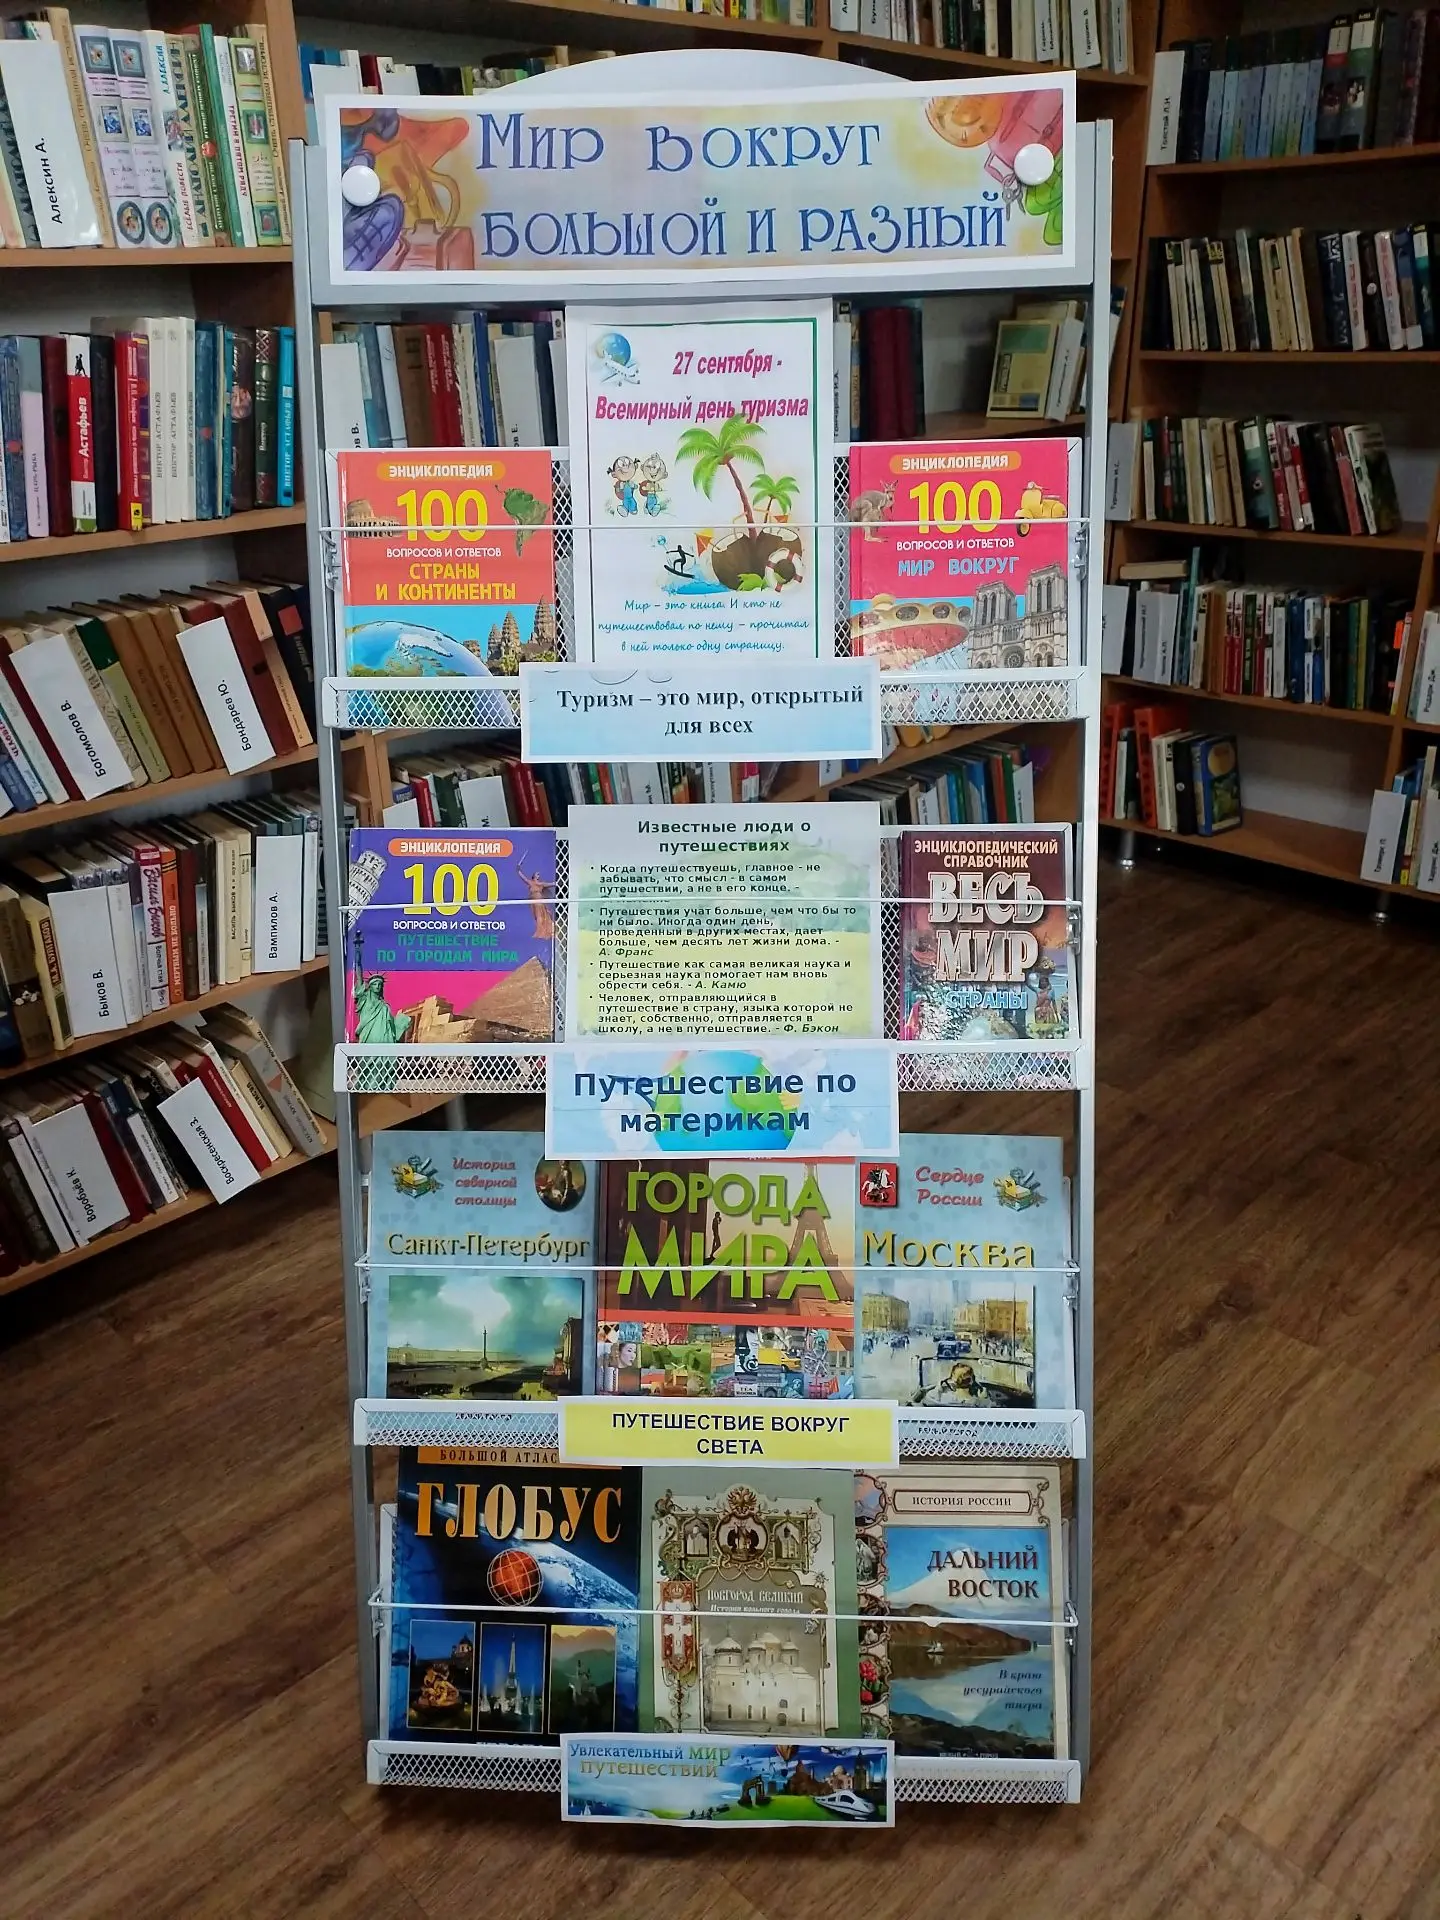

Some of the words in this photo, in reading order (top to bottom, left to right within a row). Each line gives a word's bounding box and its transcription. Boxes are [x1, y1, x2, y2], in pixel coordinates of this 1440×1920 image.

[35, 137, 46, 153] А.
[40, 155, 63, 224] Алексин
[673, 352, 693, 375] 27
[698, 349, 772, 378] сентября
[596, 395, 692, 425] Всемирный
[696, 400, 735, 422] день
[741, 397, 808, 423] туризма
[76, 397, 92, 457] Астафьев
[902, 454, 1009, 470] ЭНЦИКЛОПЕДИЯ
[389, 465, 493, 479] ЭНЦИКЛОПЕДИЯ
[397, 489, 488, 542] 100
[910, 480, 1002, 534] 100
[387, 548, 442, 558] ВОПРОСОВ
[444, 549, 452, 557] И
[455, 547, 501, 557] ОТВЕТОВ
[897, 540, 953, 551] ВОПРОСОВ
[956, 540, 964, 549] И
[967, 538, 1014, 549] ОТВЕТОВ
[409, 563, 480, 580] СТРАНЫ
[898, 560, 934, 576] МИР
[949, 557, 1019, 575] ВОКРУГ
[376, 584, 387, 601] И
[399, 583, 516, 600] КОНТИНЕНТЫ
[624, 599, 650, 611] Мир
[665, 601, 687, 609] это
[690, 600, 725, 609] книга.
[730, 599, 738, 608] И
[743, 600, 767, 609] кто
[769, 600, 782, 608] не
[598, 621, 685, 633] путешествовал
[705, 622, 733, 633] нему
[750, 621, 809, 631] прочитал
[622, 642, 626, 651] в
[630, 641, 648, 651] ней
[652, 642, 694, 651] только
[696, 641, 720, 653] одну
[725, 641, 784, 652] страницу.
[218, 679, 228, 694] Ю.
[61, 700, 72, 712] В.
[557, 689, 634, 713] Туризм
[657, 692, 690, 706] это
[697, 691, 745, 712] мир,
[751, 686, 863, 711] открытый
[224, 698, 251, 750] Бондарев
[665, 720, 701, 736] для
[709, 719, 753, 733] всех
[69, 712, 106, 777] Богомолов
[638, 821, 737, 834] Известные
[743, 821, 793, 833] люди
[801, 821, 811, 832] о
[401, 842, 500, 854] ЭНЦИКЛОПЕДИЯ
[660, 840, 789, 853] путешествиях
[914, 839, 1057, 854] ЭНЦИКЛОПЕДИЧЕСКИЙ
[600, 864, 636, 874] Когда
[640, 864, 741, 875] путешествуешь,
[746, 863, 793, 872] главное
[807, 863, 820, 871] не
[944, 855, 1028, 868] СПРАВОЧНИК
[268, 891, 279, 904] А.
[404, 863, 499, 916] 100
[928, 871, 1043, 925] ВЕСЬ
[268, 905, 279, 960] Вампилов
[393, 920, 447, 930] ВОПРОСОВ
[450, 921, 458, 930] И
[460, 920, 505, 930] ОТВЕТОВ
[398, 934, 497, 947] ПУТЕШЕСТВИЕ
[377, 950, 396, 962] ПО
[407, 950, 471, 964] ГОРОДАМ
[482, 950, 518, 962] МИРА
[599, 960, 680, 970] Путешествие
[749, 960, 800, 968] великая
[804, 960, 840, 969] наука
[935, 930, 1038, 983] МИР
[92, 969, 103, 979] В.
[96, 982, 110, 1017] Быков
[947, 990, 1027, 1010] СТРАНЫ
[574, 1072, 804, 1102] Путешествие
[817, 1073, 856, 1093] по
[189, 1116, 199, 1127] З.
[621, 1109, 810, 1137] материкам
[196, 1126, 234, 1185] Воскресенская
[453, 1157, 516, 1171] История
[455, 1175, 517, 1189] северной
[915, 1166, 985, 1187] Сердце
[455, 1195, 517, 1208] столицы
[627, 1172, 830, 1225] ГОРОДА
[916, 1189, 982, 1207] России
[386, 1232, 590, 1263] Санкт-Петербург
[862, 1231, 1034, 1268] Москва
[617, 1225, 839, 1300] МИРА
[613, 1413, 764, 1431] ПУТЕШЕСТВИЕ
[772, 1416, 849, 1432] ВОКРУГ
[440, 1448, 507, 1463] БОЛЬШОЙ
[515, 1451, 558, 1463] АТЛАС
[697, 1439, 763, 1455] СВЕТА
[912, 1496, 964, 1506] ИСТОРИЯ
[968, 1497, 1011, 1506] РОССИИ
[415, 1482, 622, 1543] ГЛОБУС
[928, 1545, 1038, 1571] ДАЛЬНИЙ
[949, 1580, 1039, 1599] ВОСТОК
[1000, 1669, 1007, 1679] В
[1011, 1671, 1041, 1680] краю
[1004, 1701, 1042, 1710] тигра
[571, 1744, 683, 1759] Увлекательный
[689, 1747, 731, 1766] мир
[580, 1759, 718, 1778] путешествий
